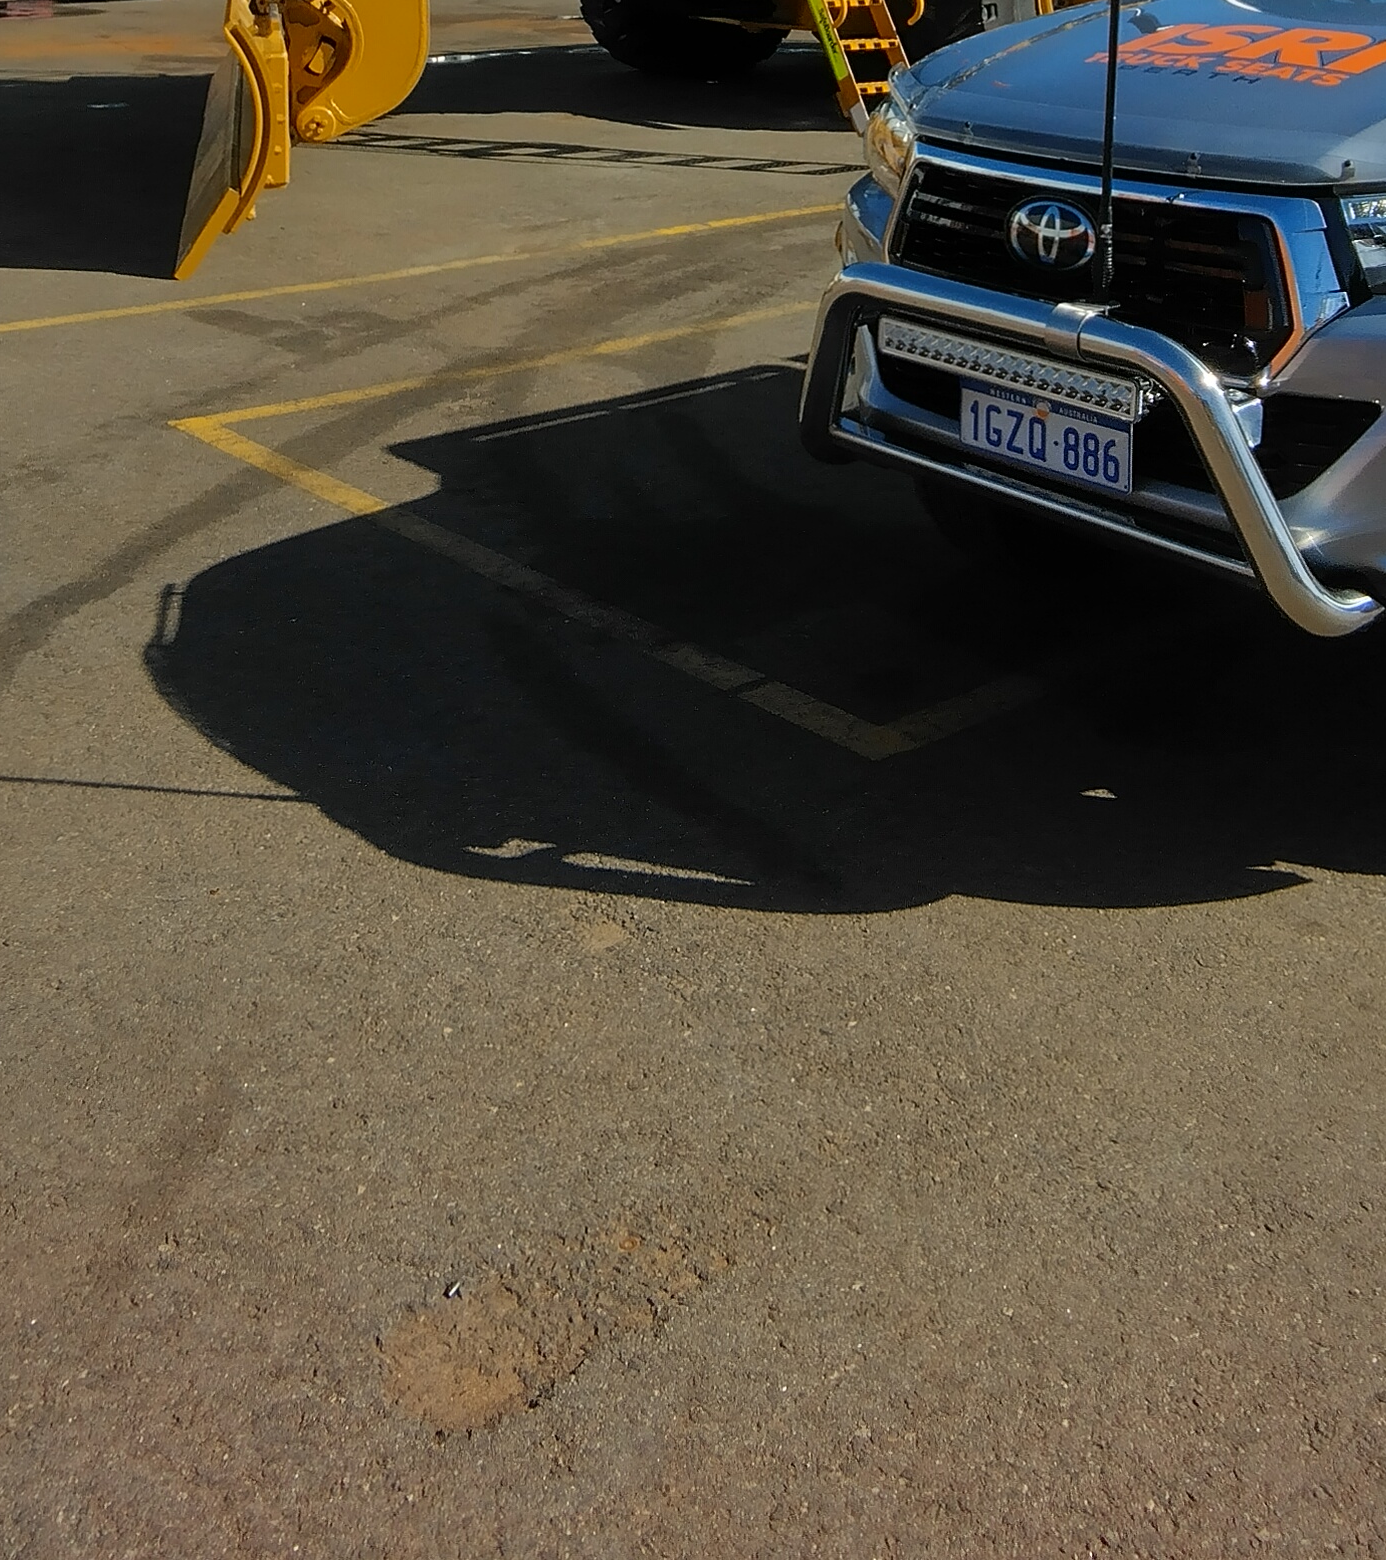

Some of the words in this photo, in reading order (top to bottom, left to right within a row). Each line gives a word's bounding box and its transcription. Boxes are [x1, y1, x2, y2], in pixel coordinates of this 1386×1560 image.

[1215, 60, 1350, 86] SEATS
[989, 389, 1027, 405] WESTERN
[1059, 407, 1098, 424] AUSTRALIA
